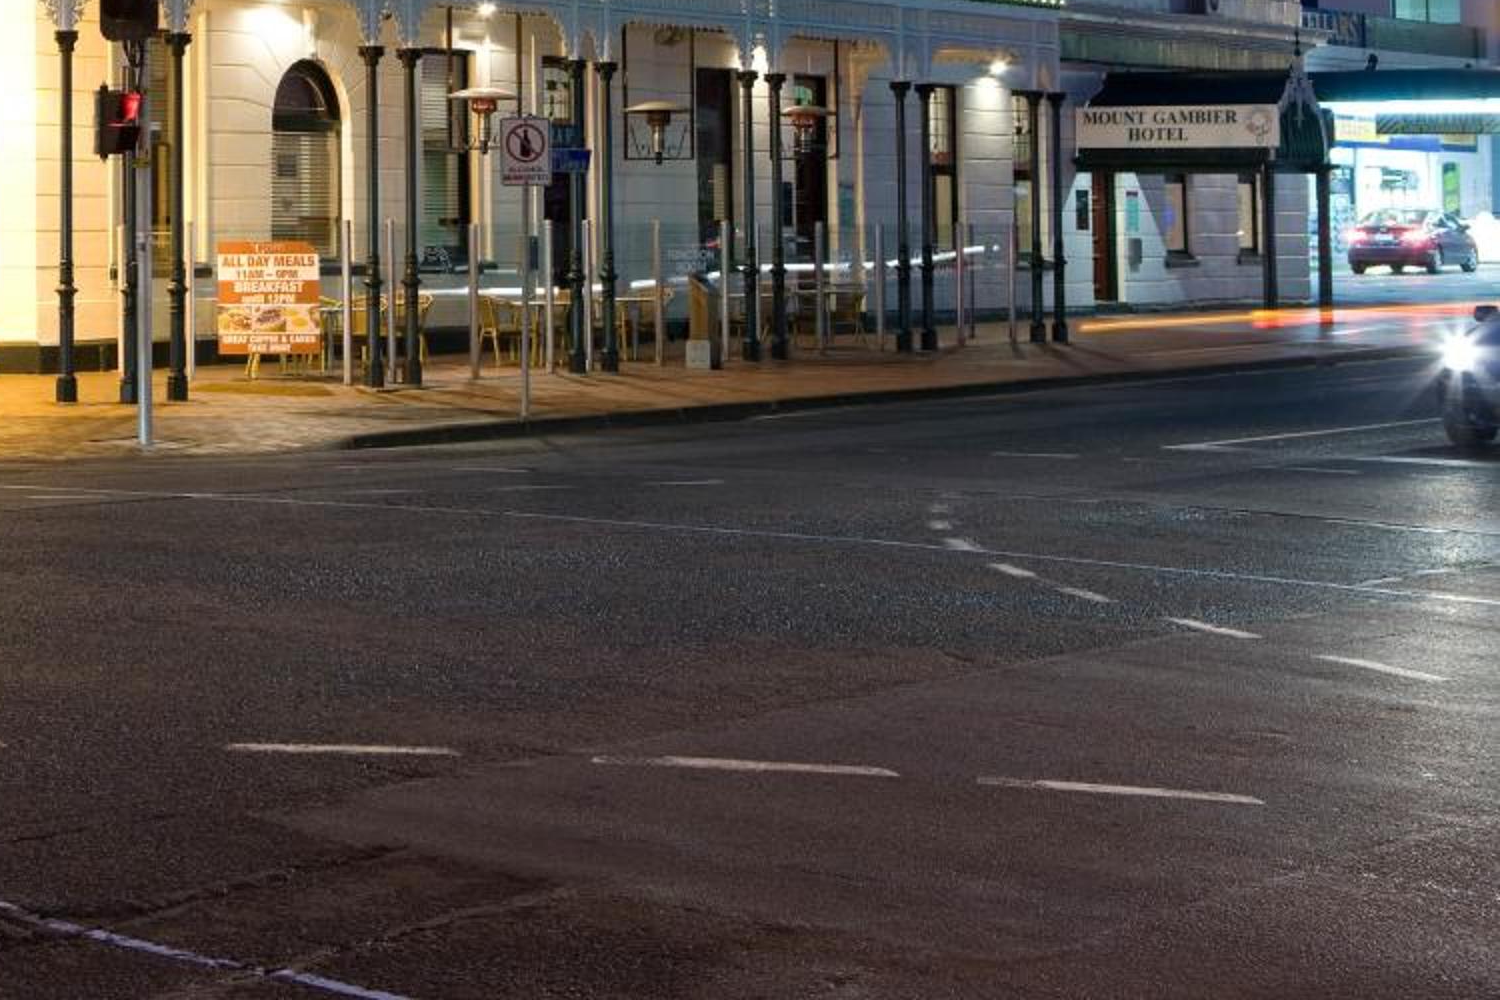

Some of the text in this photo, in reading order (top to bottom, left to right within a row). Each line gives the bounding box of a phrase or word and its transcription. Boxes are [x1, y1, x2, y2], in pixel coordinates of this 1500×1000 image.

[1083, 109, 1238, 126] MOUNT GAMBIER
[1128, 127, 1188, 142] HOTEL
[222, 255, 315, 267] ALL DAY MEALS
[233, 281, 304, 293] BREAKFAST
